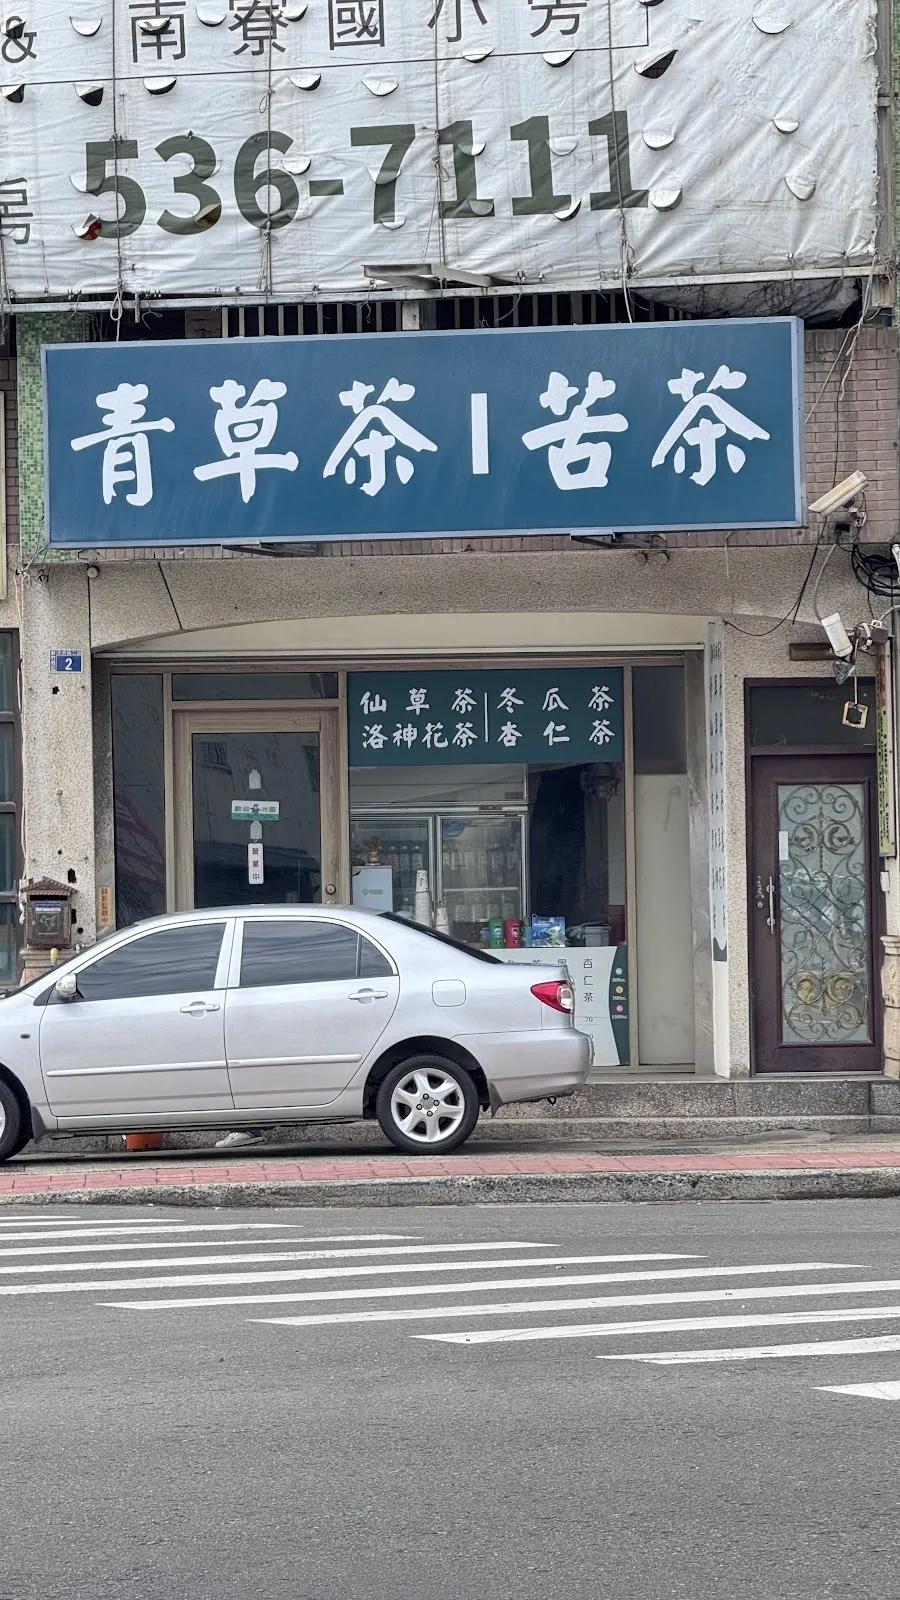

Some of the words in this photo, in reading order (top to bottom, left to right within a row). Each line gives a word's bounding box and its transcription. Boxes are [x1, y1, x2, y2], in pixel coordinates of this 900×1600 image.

[83, 109, 650, 239] 536-7111
[71, 379, 438, 507] 青草茶
[522, 364, 771, 490] 苦茶
[64, 657, 73, 671] 2
[360, 688, 478, 716] 仙草茶
[496, 686, 615, 714] 冬瓜茶
[361, 722, 478, 749] 洛神花茶
[497, 719, 615, 747] 杏仁茶
[252, 847, 260, 881] 營業中
[583, 958, 594, 1003] 杏仁茶
